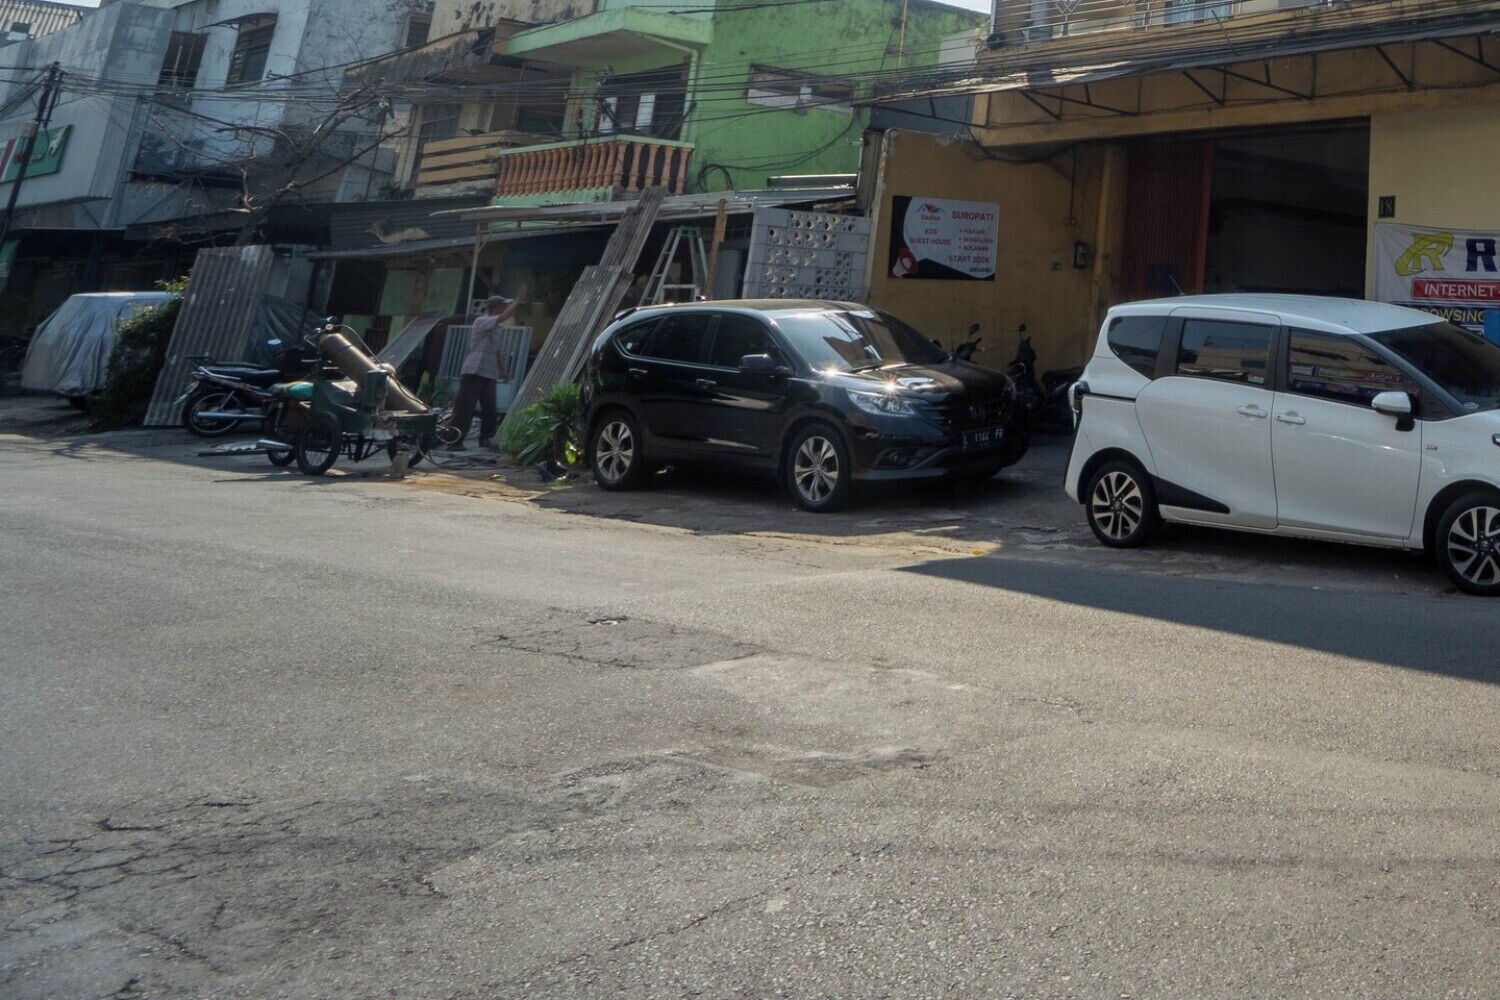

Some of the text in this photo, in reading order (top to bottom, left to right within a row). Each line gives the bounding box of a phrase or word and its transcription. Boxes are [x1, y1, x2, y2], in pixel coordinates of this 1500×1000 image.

[952, 211, 993, 221] SUROPATI
[949, 255, 971, 263] START
[1424, 283, 1496, 297] INTERNET
